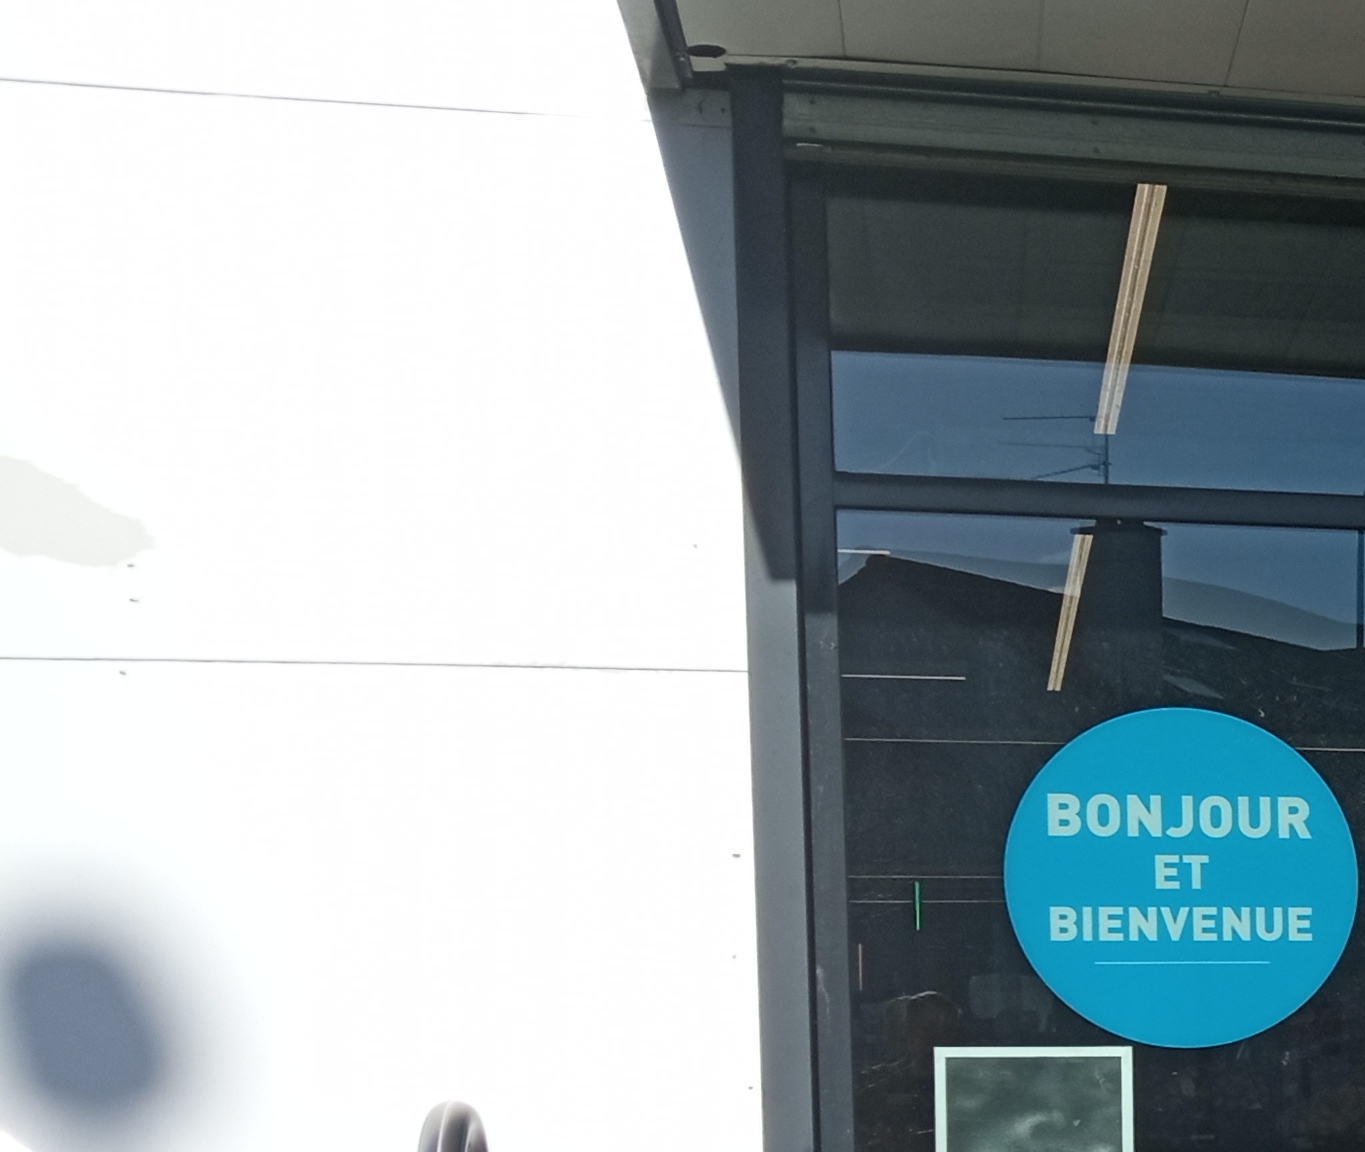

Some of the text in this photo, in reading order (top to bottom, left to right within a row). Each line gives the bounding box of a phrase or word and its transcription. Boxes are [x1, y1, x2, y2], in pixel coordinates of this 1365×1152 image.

[1047, 793, 1312, 839] BONJOUR
[1155, 855, 1209, 889] ET
[1049, 906, 1313, 942] BIENVENUE
